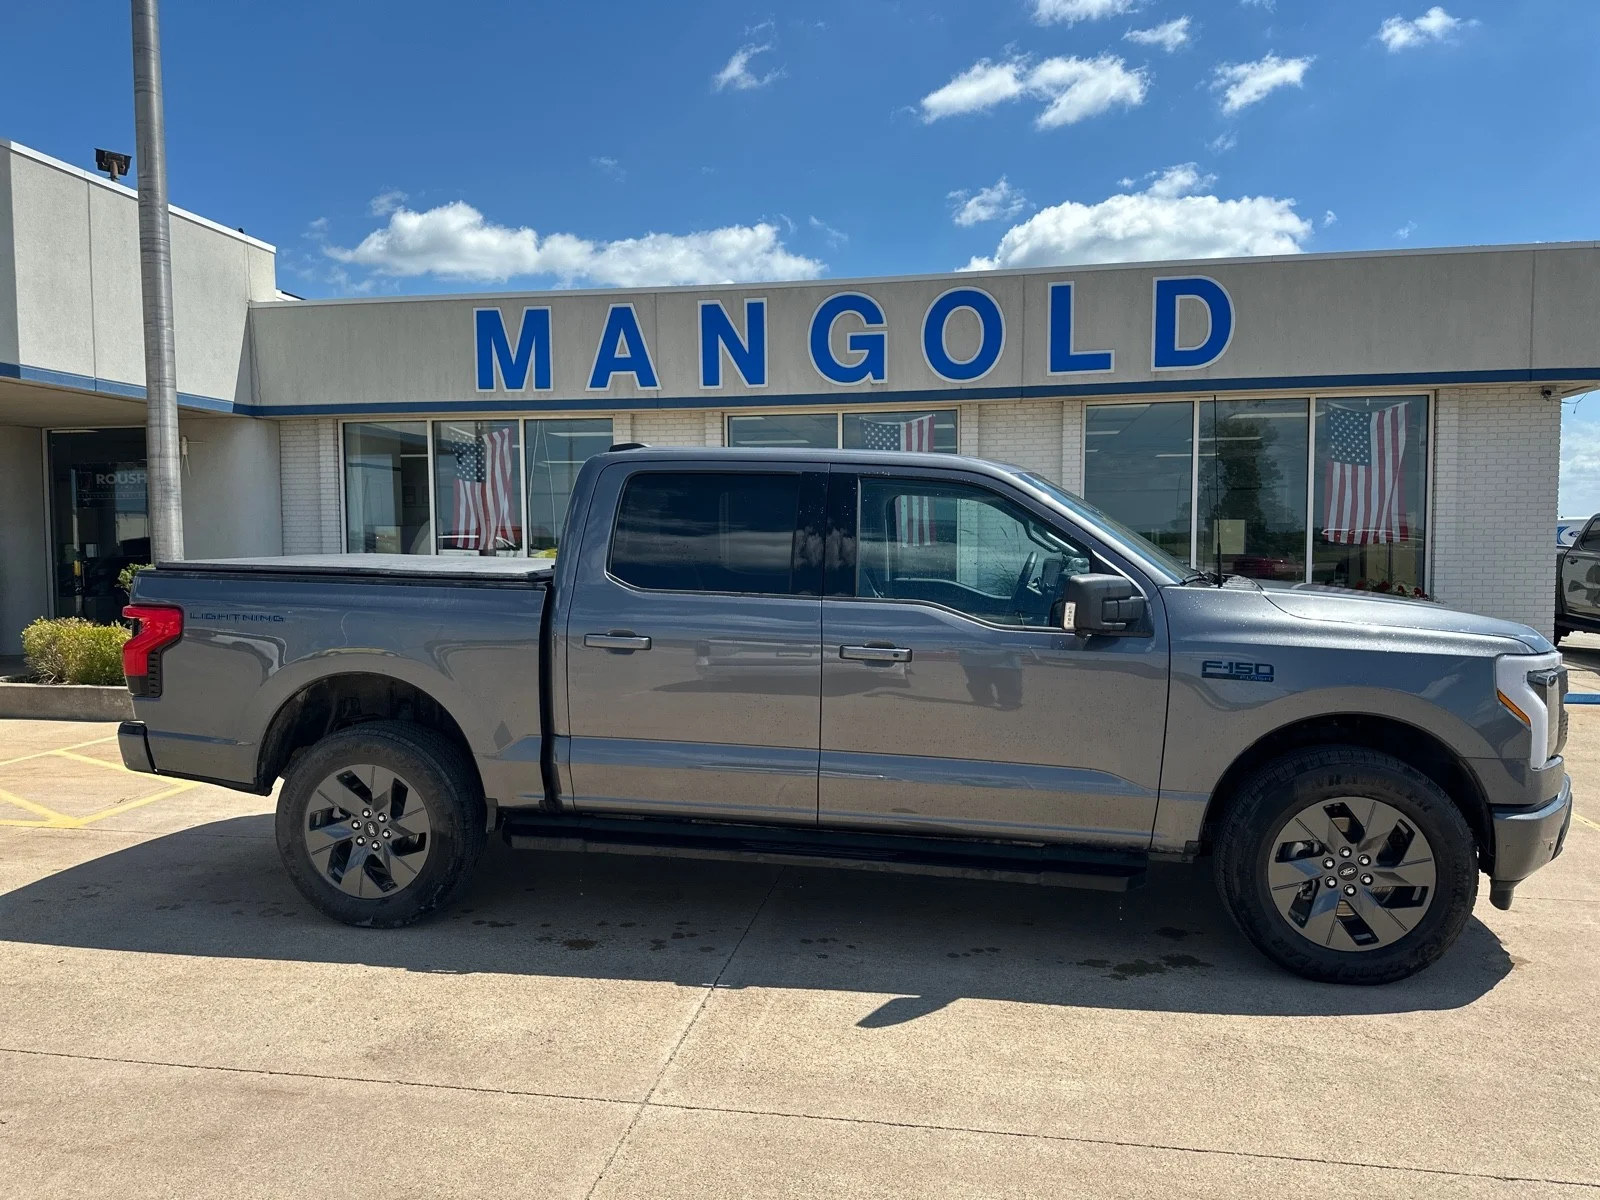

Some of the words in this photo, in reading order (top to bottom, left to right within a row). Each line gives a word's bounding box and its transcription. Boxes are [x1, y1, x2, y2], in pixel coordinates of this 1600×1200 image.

[473, 275, 1236, 392] MANGOLD
[95, 473, 147, 485] ROUSH
[189, 611, 284, 623] LIGHTNING
[1202, 660, 1275, 676] F-150
